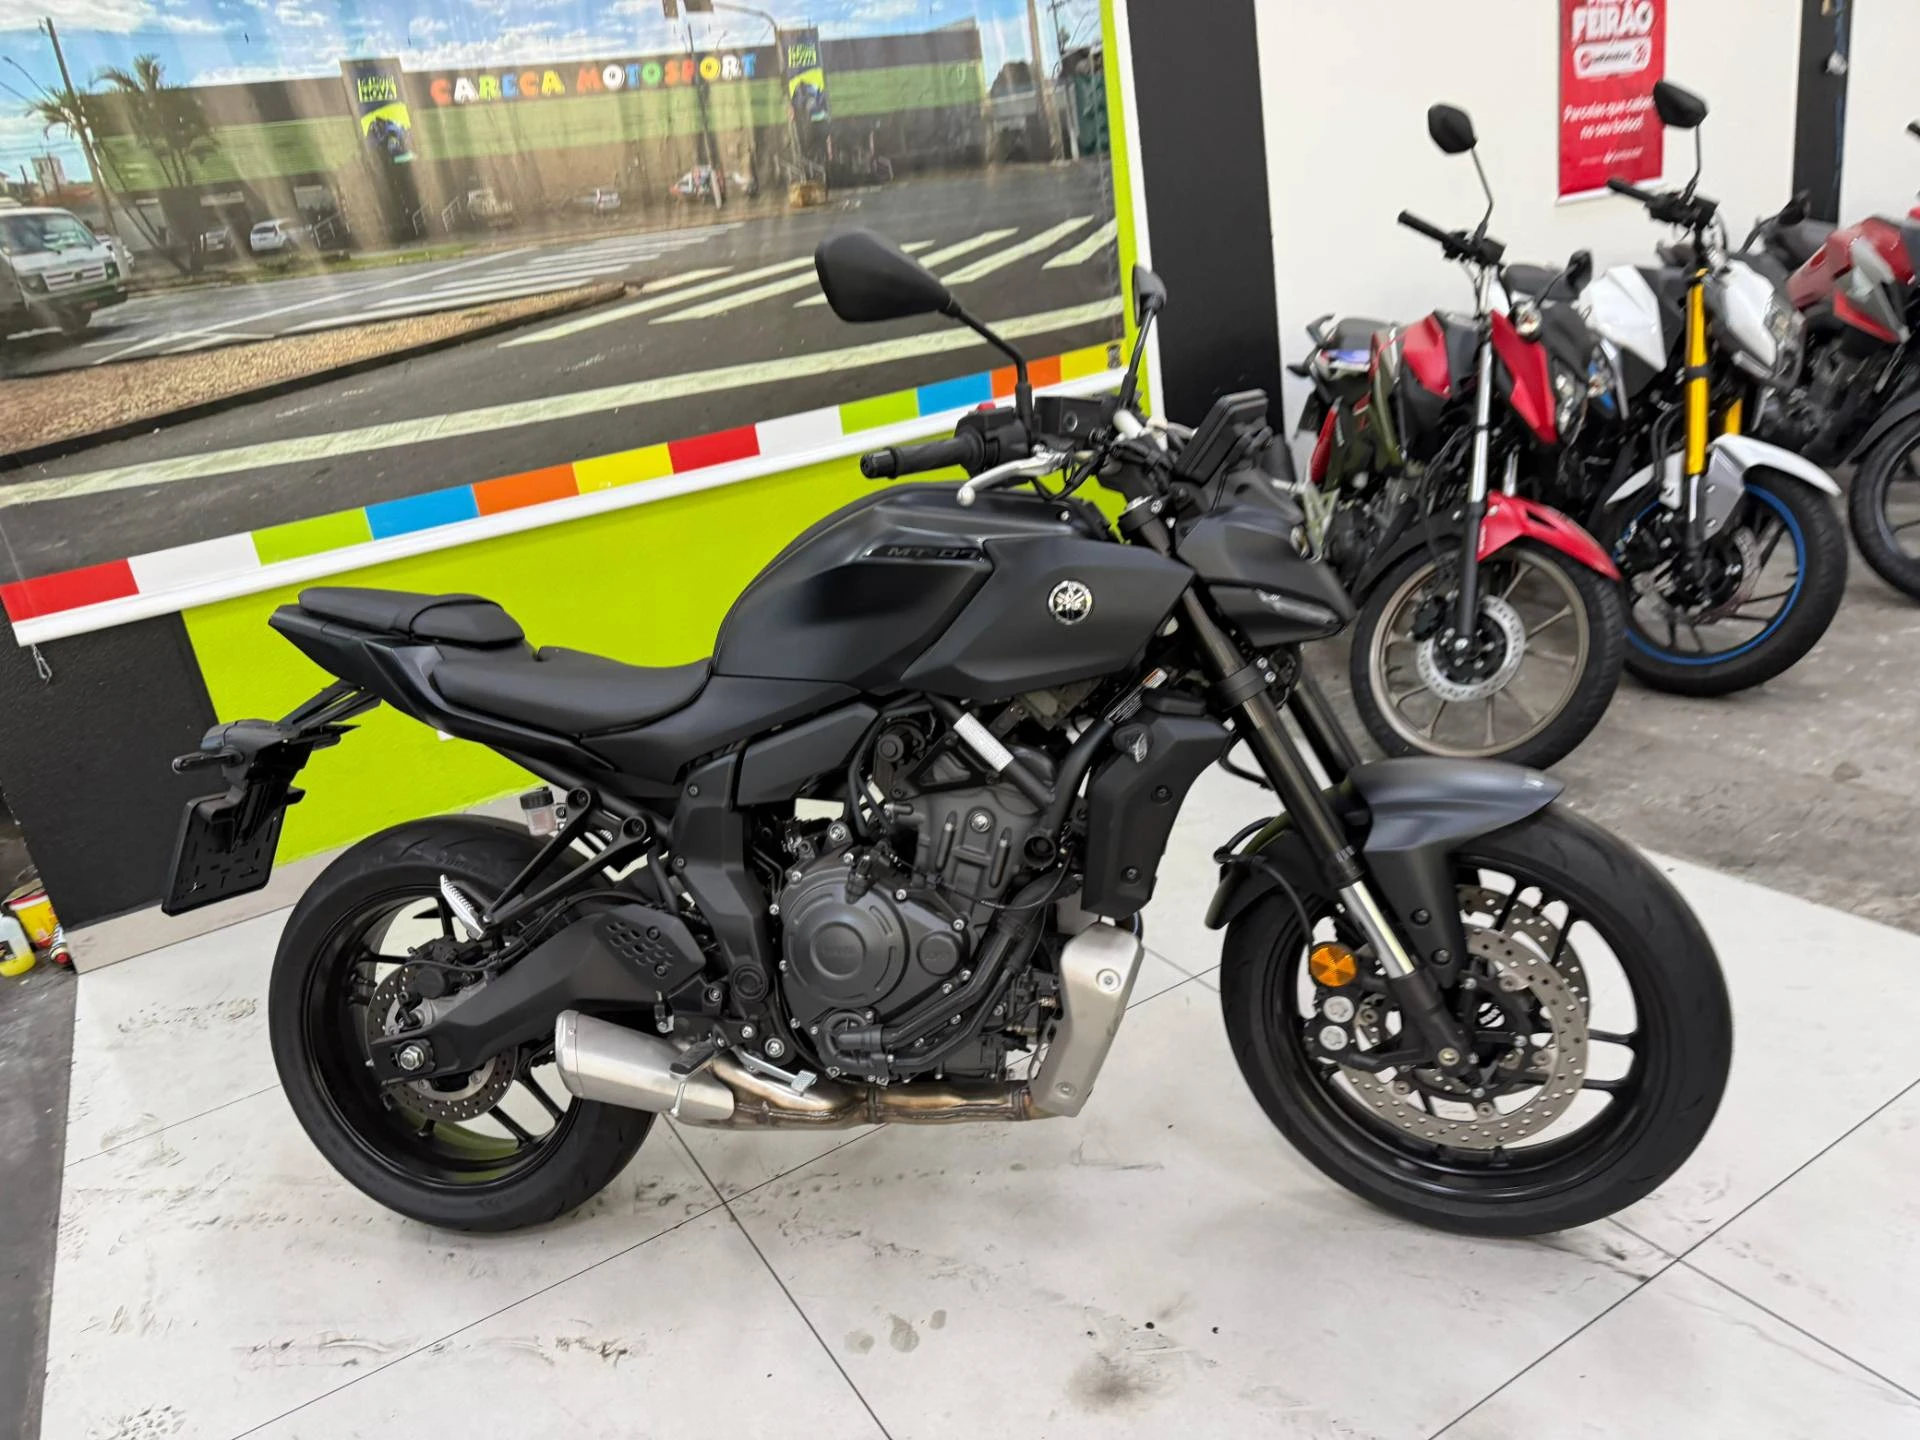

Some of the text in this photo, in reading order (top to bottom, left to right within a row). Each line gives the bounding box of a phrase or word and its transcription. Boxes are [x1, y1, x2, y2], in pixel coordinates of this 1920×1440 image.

[1571, 0, 1654, 42] FEIRÃO
[429, 70, 566, 105] CARECA
[576, 52, 757, 94] MOTOSPORT
